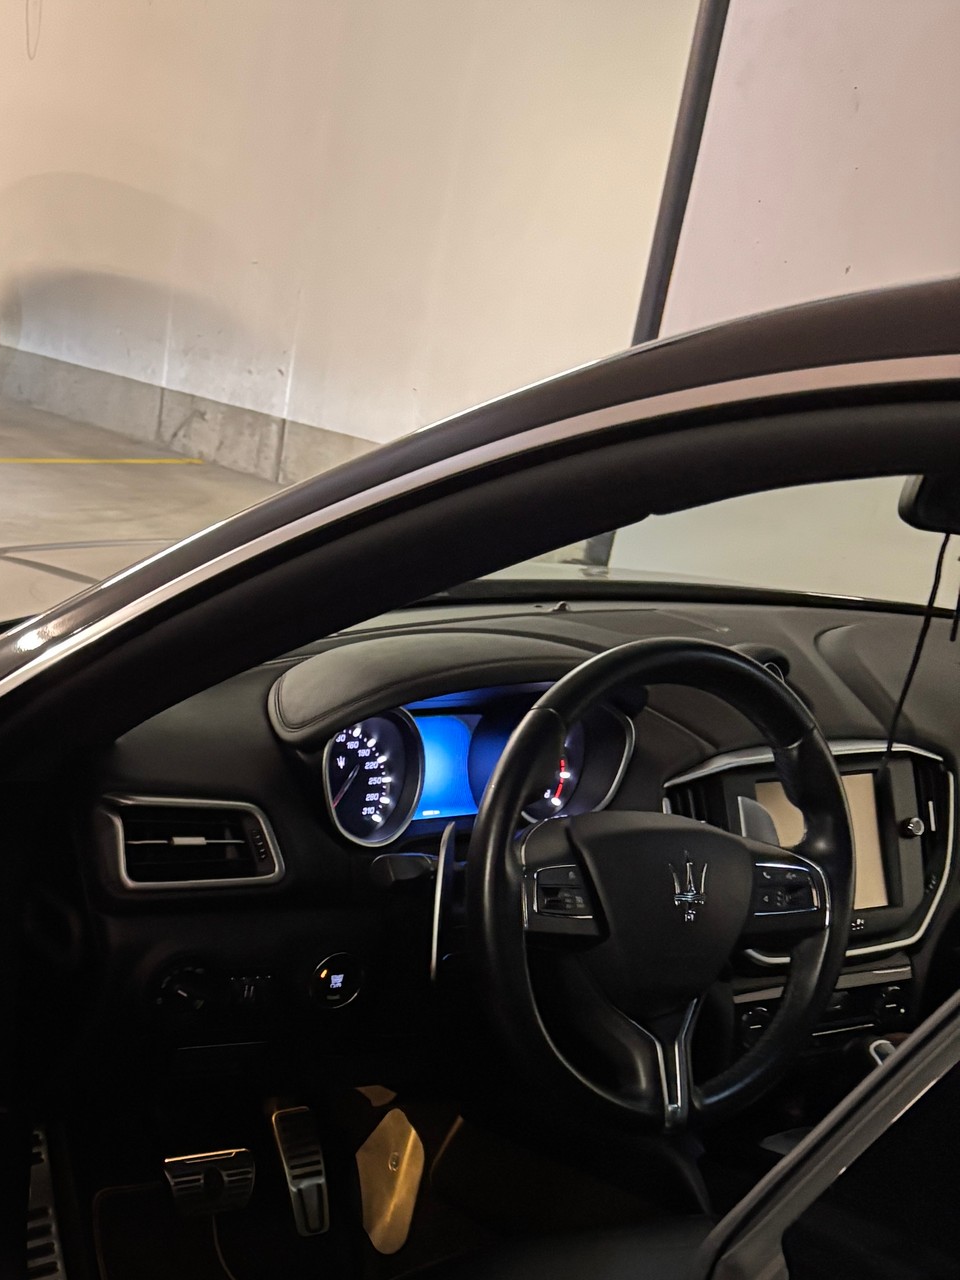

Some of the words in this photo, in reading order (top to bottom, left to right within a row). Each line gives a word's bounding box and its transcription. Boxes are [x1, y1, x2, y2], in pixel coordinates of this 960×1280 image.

[357, 748, 371, 757] 190
[364, 761, 379, 770] 220
[368, 776, 382, 785] 250
[361, 806, 375, 815] 310
